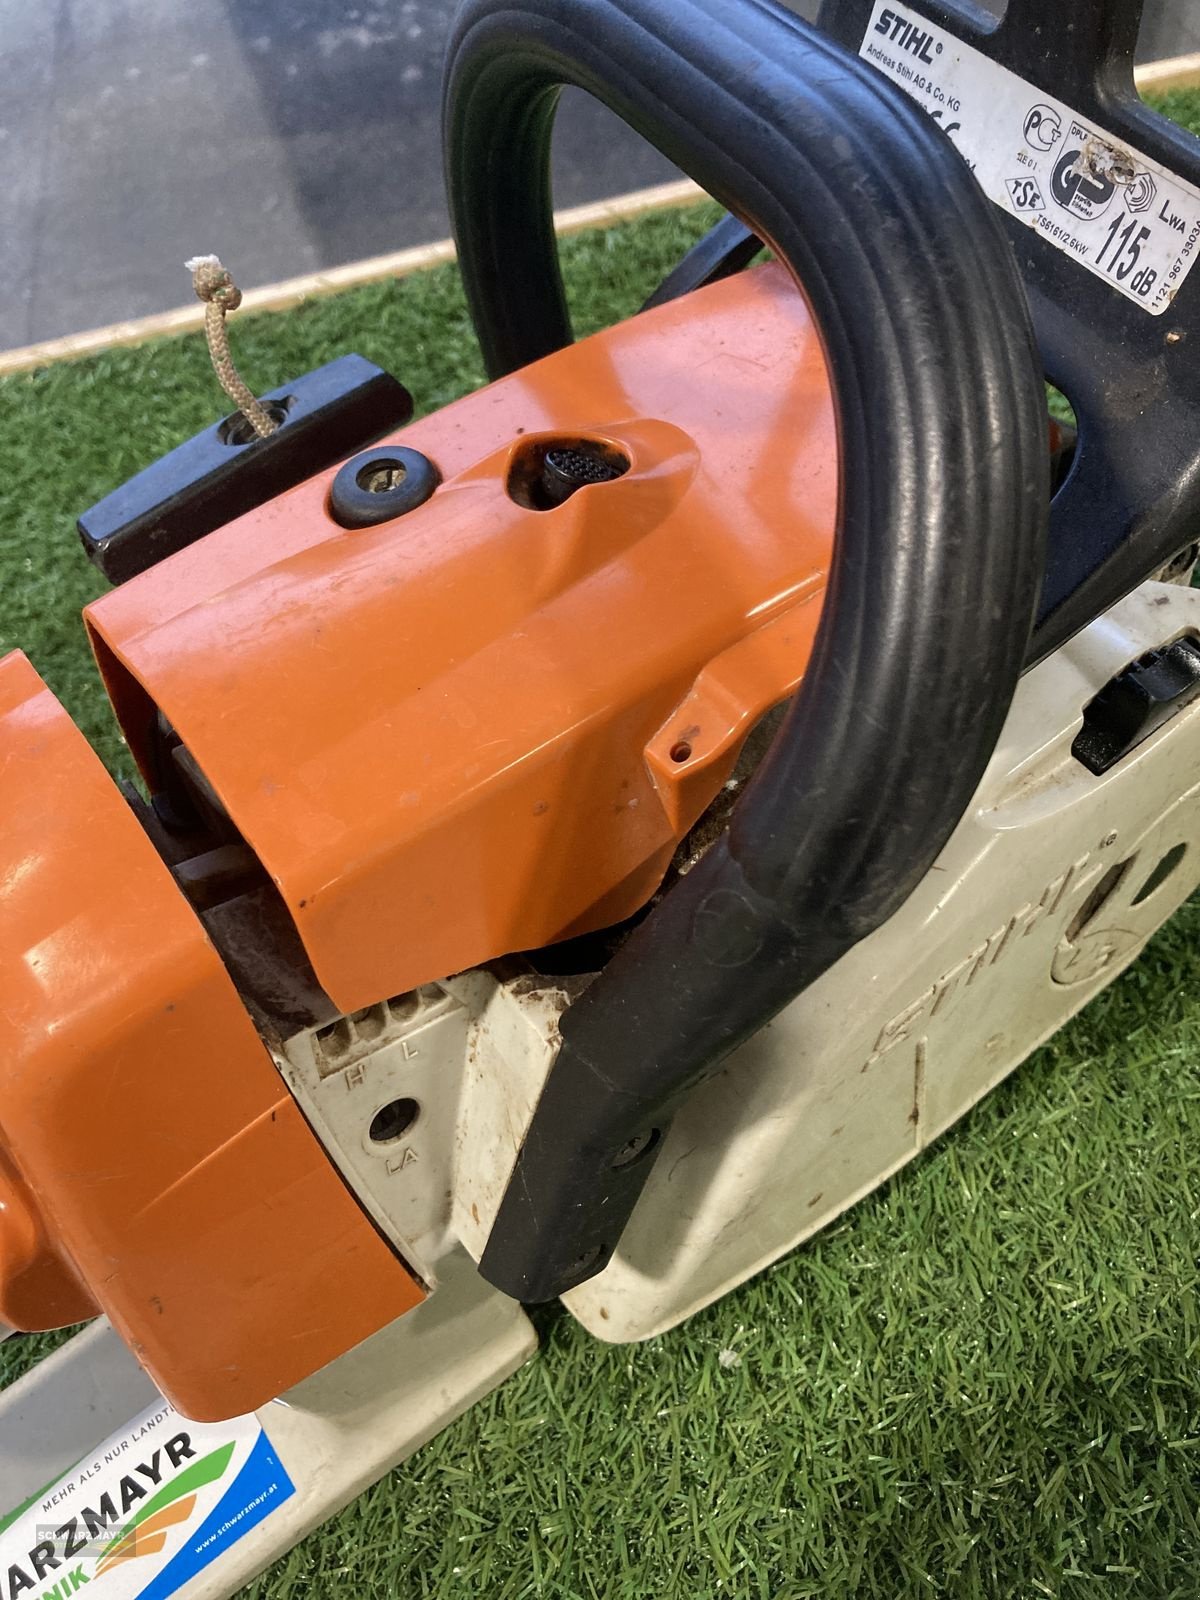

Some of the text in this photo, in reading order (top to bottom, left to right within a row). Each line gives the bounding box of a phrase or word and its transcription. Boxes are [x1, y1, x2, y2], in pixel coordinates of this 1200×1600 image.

[866, 43, 895, 70] Andreas
[896, 62, 914, 80] Stihl
[912, 73, 926, 89] AG
[925, 82, 933, 94] &
[933, 87, 945, 104] Co.
[946, 95, 961, 112] KG
[1011, 179, 1041, 209] TSE
[1037, 214, 1089, 255] TS6161/2.6kW
[1095, 211, 1152, 281] 115
[1130, 266, 1158, 297] dB
[1151, 282, 1171, 309] 1121
[1168, 257, 1184, 280] 967
[401, 1041, 420, 1061] L
[345, 1064, 366, 1091] H
[385, 1146, 420, 1177] LA
[42, 1482, 76, 1513] MEHR
[79, 1462, 102, 1486] ALS
[104, 1440, 130, 1464] NUR
[0, 1432, 198, 1600] ARZMAYR
[194, 1482, 279, 1554] www.schwarzmayr.at
